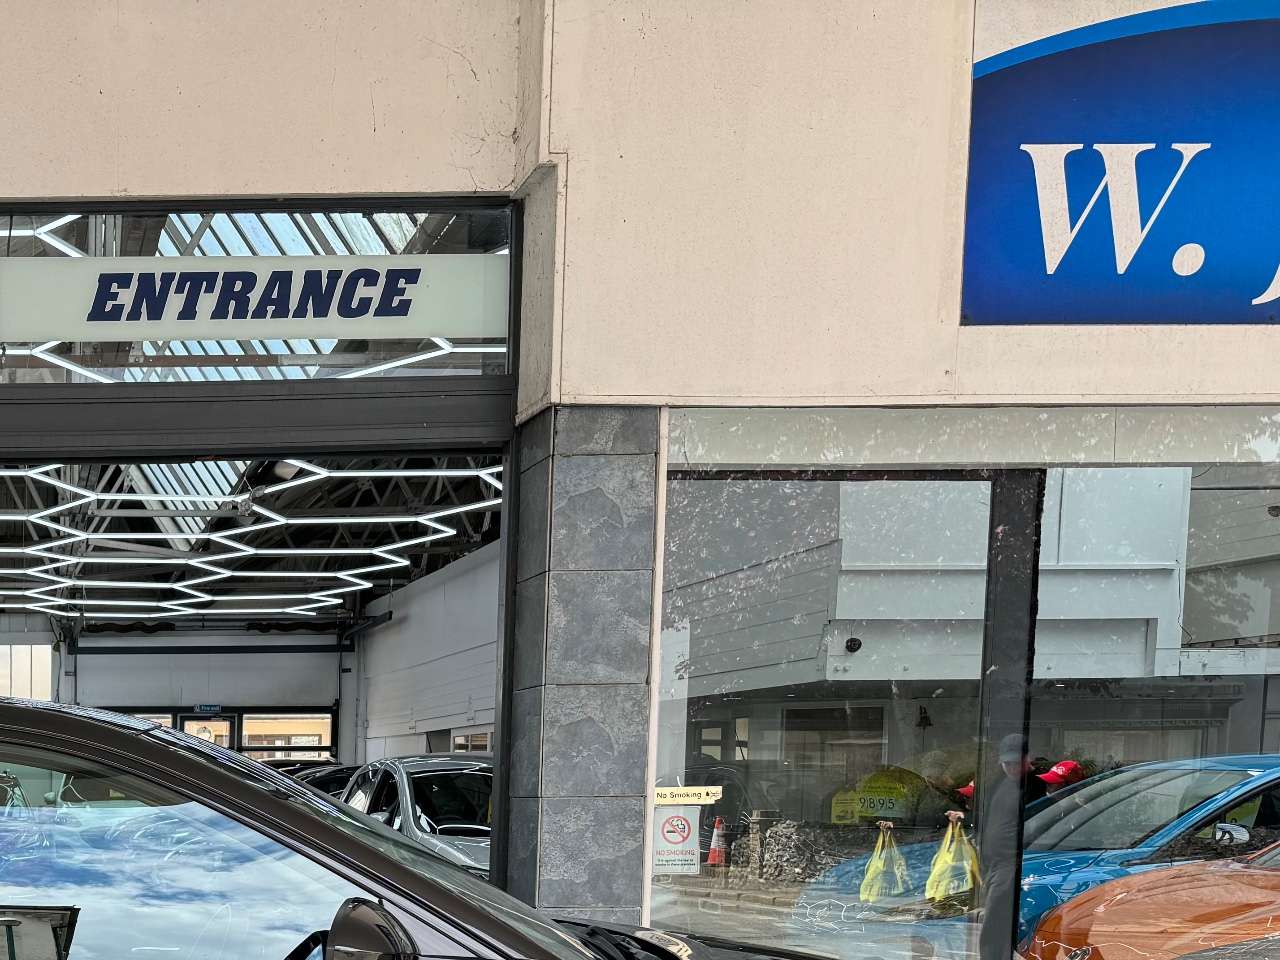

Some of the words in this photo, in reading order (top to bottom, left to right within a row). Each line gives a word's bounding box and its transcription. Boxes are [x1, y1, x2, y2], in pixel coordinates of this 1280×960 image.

[1019, 142, 1212, 277] W.
[86, 267, 422, 323] ENTRANCE
[669, 791, 702, 799] Smoking
